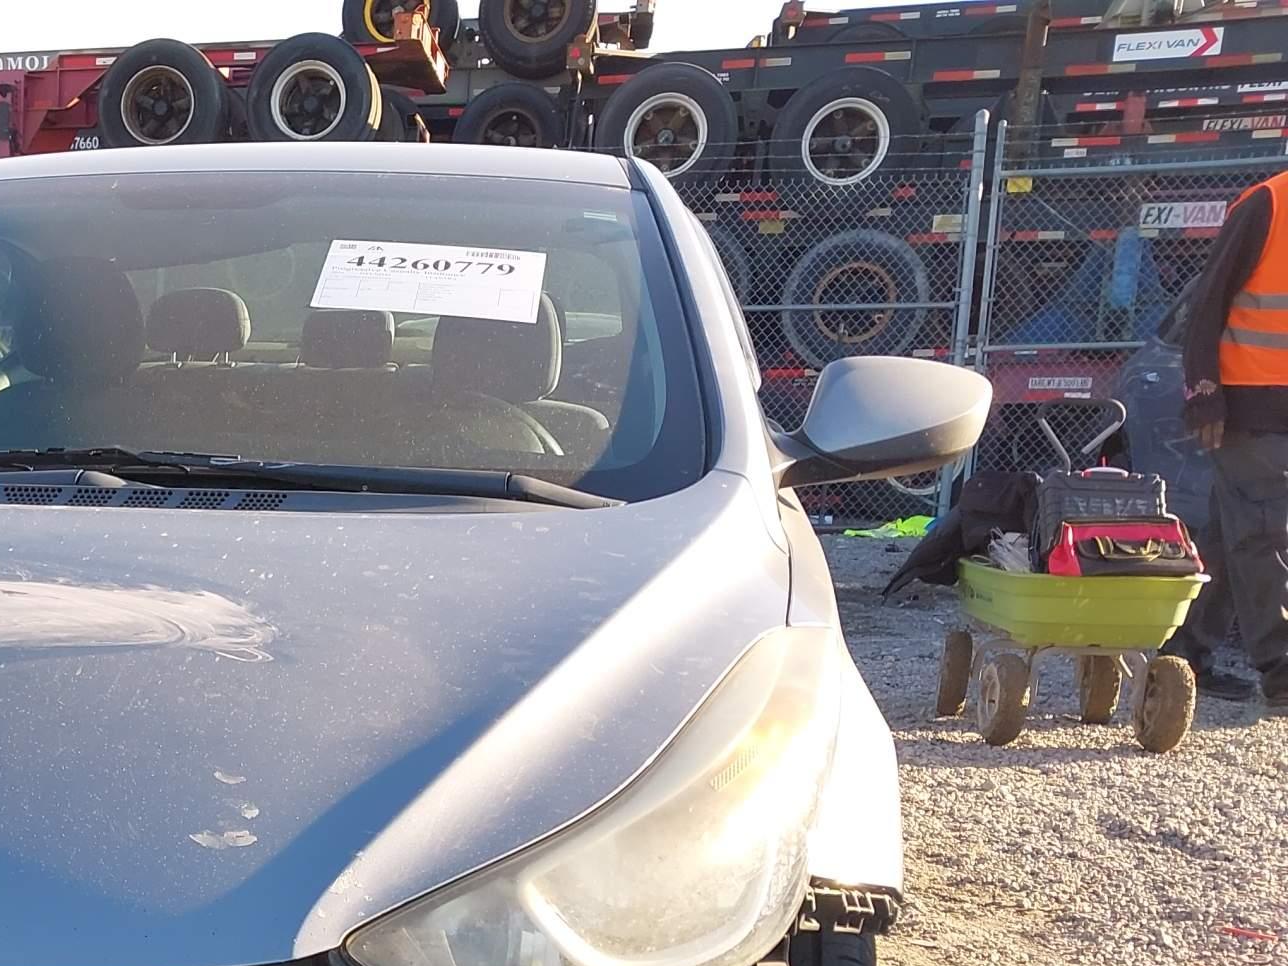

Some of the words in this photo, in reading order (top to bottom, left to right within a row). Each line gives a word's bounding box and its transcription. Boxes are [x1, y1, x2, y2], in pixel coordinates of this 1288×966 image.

[1116, 41, 1162, 52] FLEXI
[1166, 38, 1200, 48] VAN
[70, 136, 99, 149] 7660
[346, 255, 516, 276] 44260779
